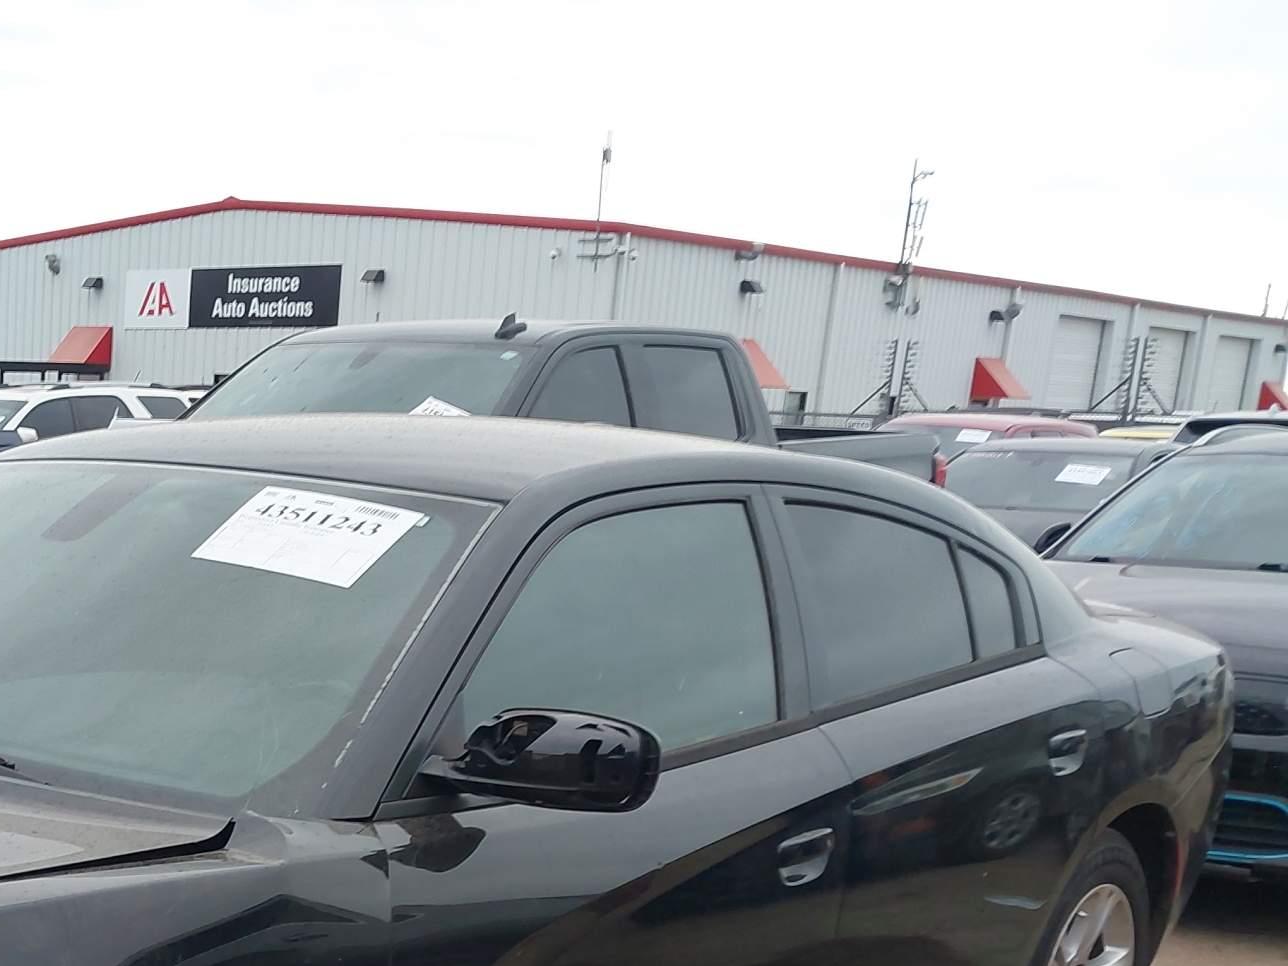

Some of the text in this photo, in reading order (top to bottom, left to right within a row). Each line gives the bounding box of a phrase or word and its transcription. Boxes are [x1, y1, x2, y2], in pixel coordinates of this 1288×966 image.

[227, 273, 300, 294] Insurance
[212, 296, 314, 318] Auto Auctions
[255, 503, 382, 536] 43511243
